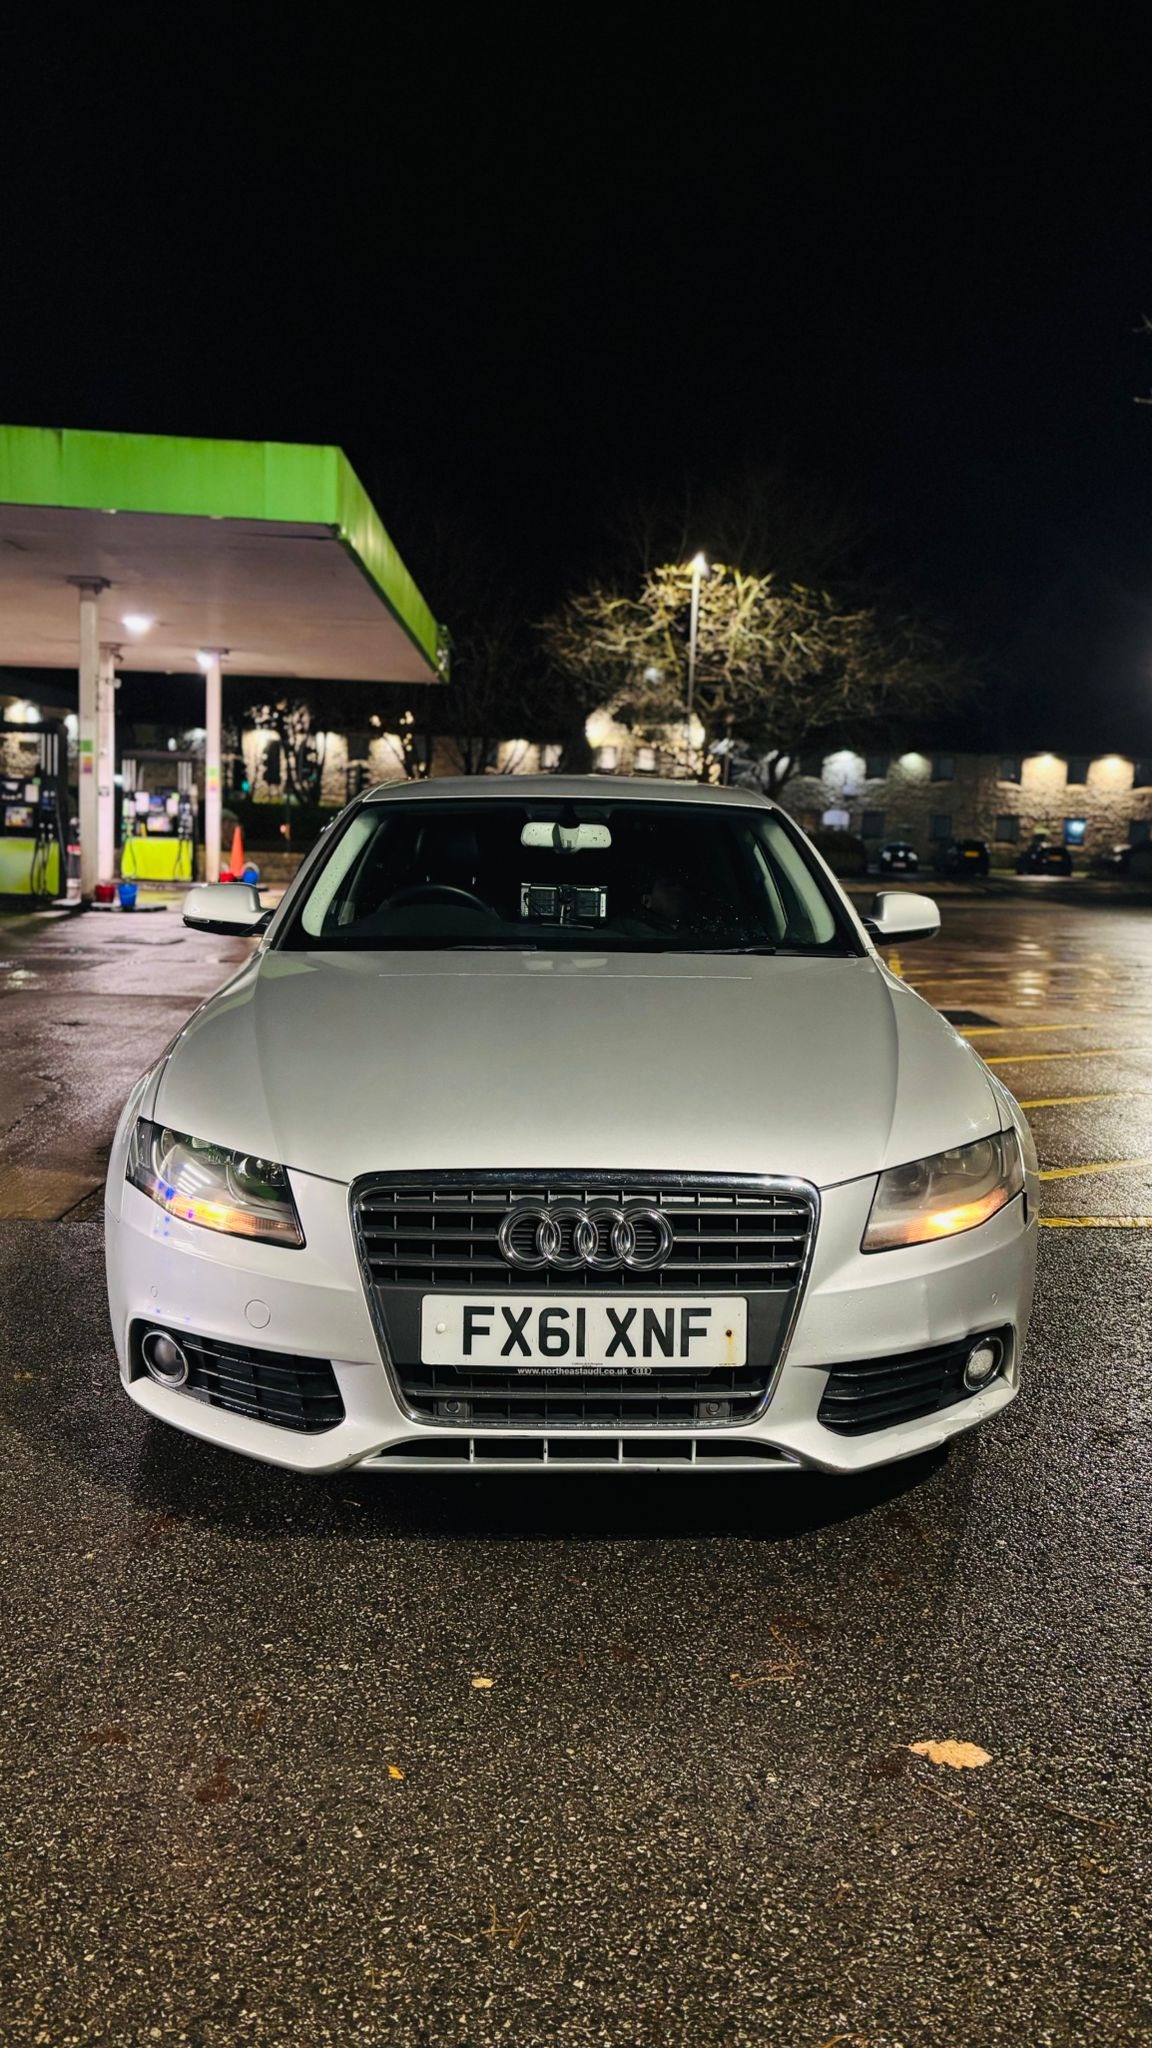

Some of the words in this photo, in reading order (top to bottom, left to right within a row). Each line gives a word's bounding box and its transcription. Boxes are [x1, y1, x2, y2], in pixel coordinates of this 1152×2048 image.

[462, 1305, 586, 1357] FX61
[605, 1307, 712, 1358] XNF
[517, 1366, 628, 1376] www.northeastaudi.co.uk
